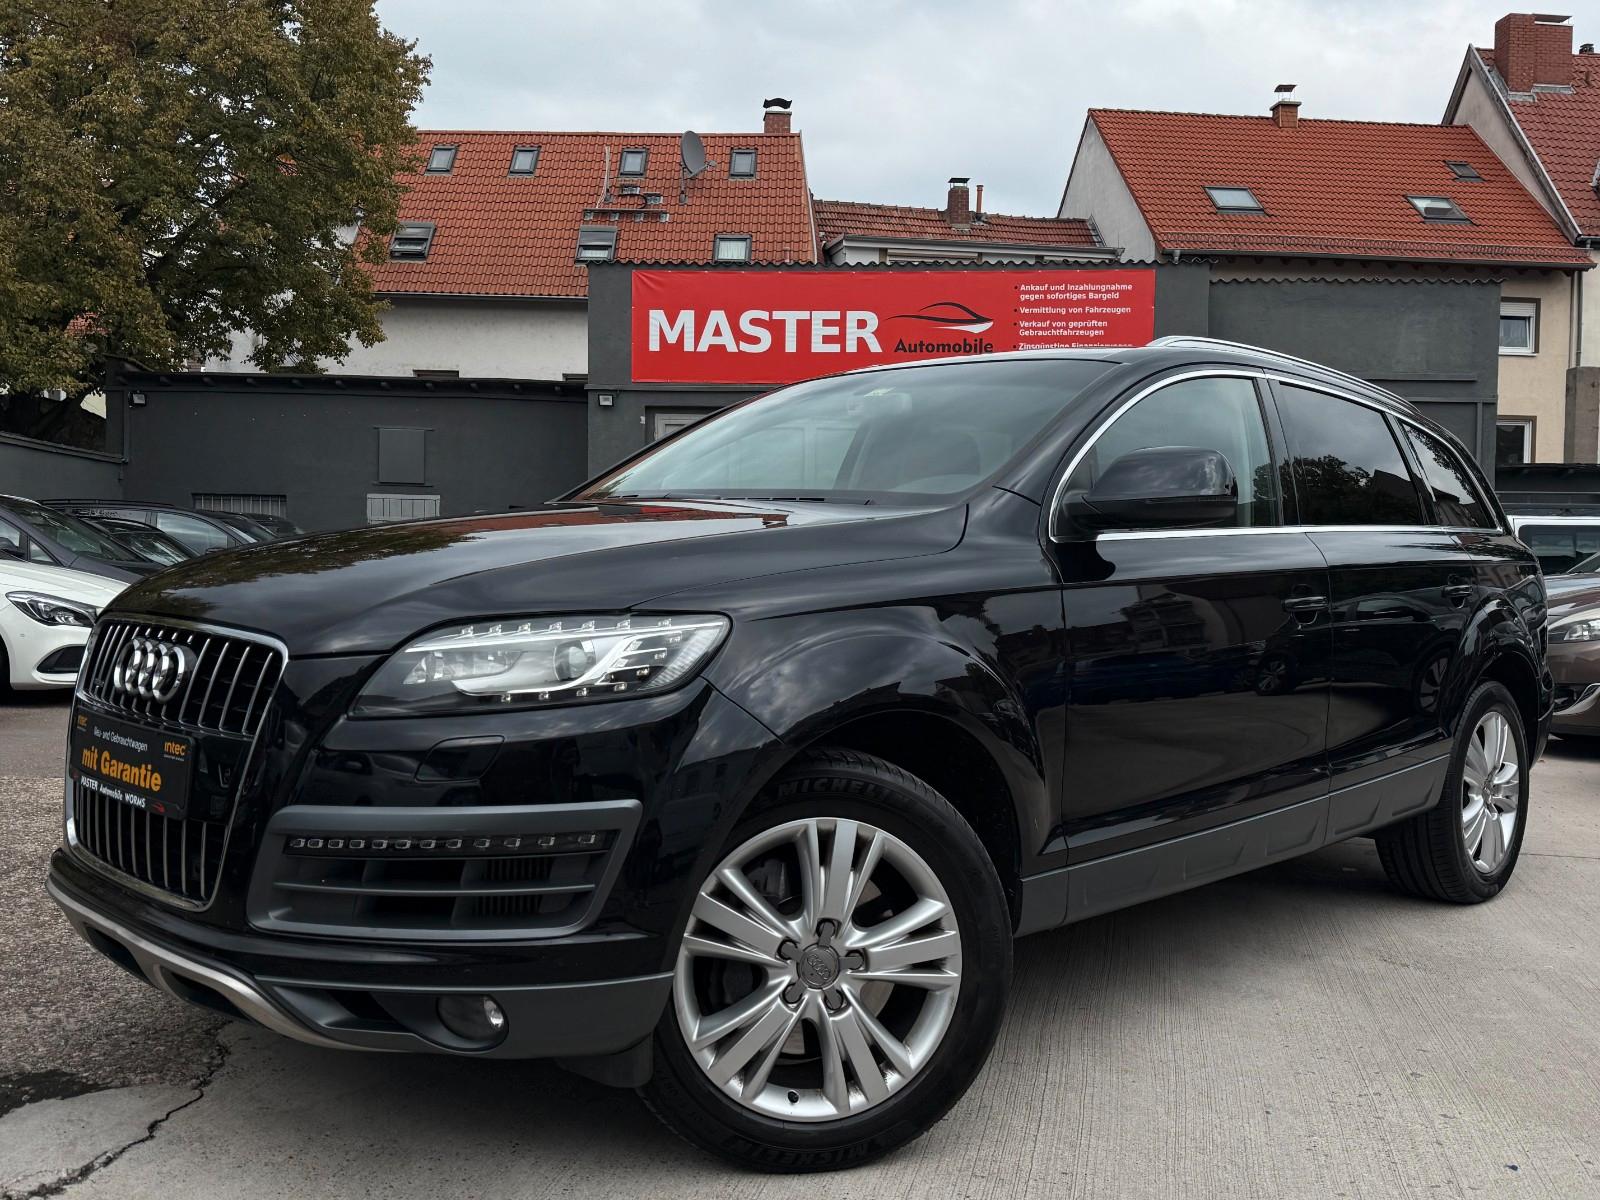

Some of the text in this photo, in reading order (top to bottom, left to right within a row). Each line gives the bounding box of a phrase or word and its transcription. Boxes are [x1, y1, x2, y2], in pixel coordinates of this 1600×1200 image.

[1020, 283, 1133, 292] Ankauf und Inzahlungnahme
[1020, 292, 1119, 301] gegen sofortiges Bargeld
[1020, 306, 1066, 315] Vermittlung
[1085, 306, 1131, 315] Fahrzeugen
[1019, 320, 1050, 328] Verkauf
[1068, 319, 1108, 329] geprüften
[648, 309, 883, 353] MASTER
[1019, 328, 1104, 337] Gebrauchtfahrzeugen
[893, 338, 994, 354] Automobile
[111, 731, 148, 752] Gebrauchtwagen
[82, 746, 162, 791] mit Garantie
[125, 792, 146, 808] WORMS
